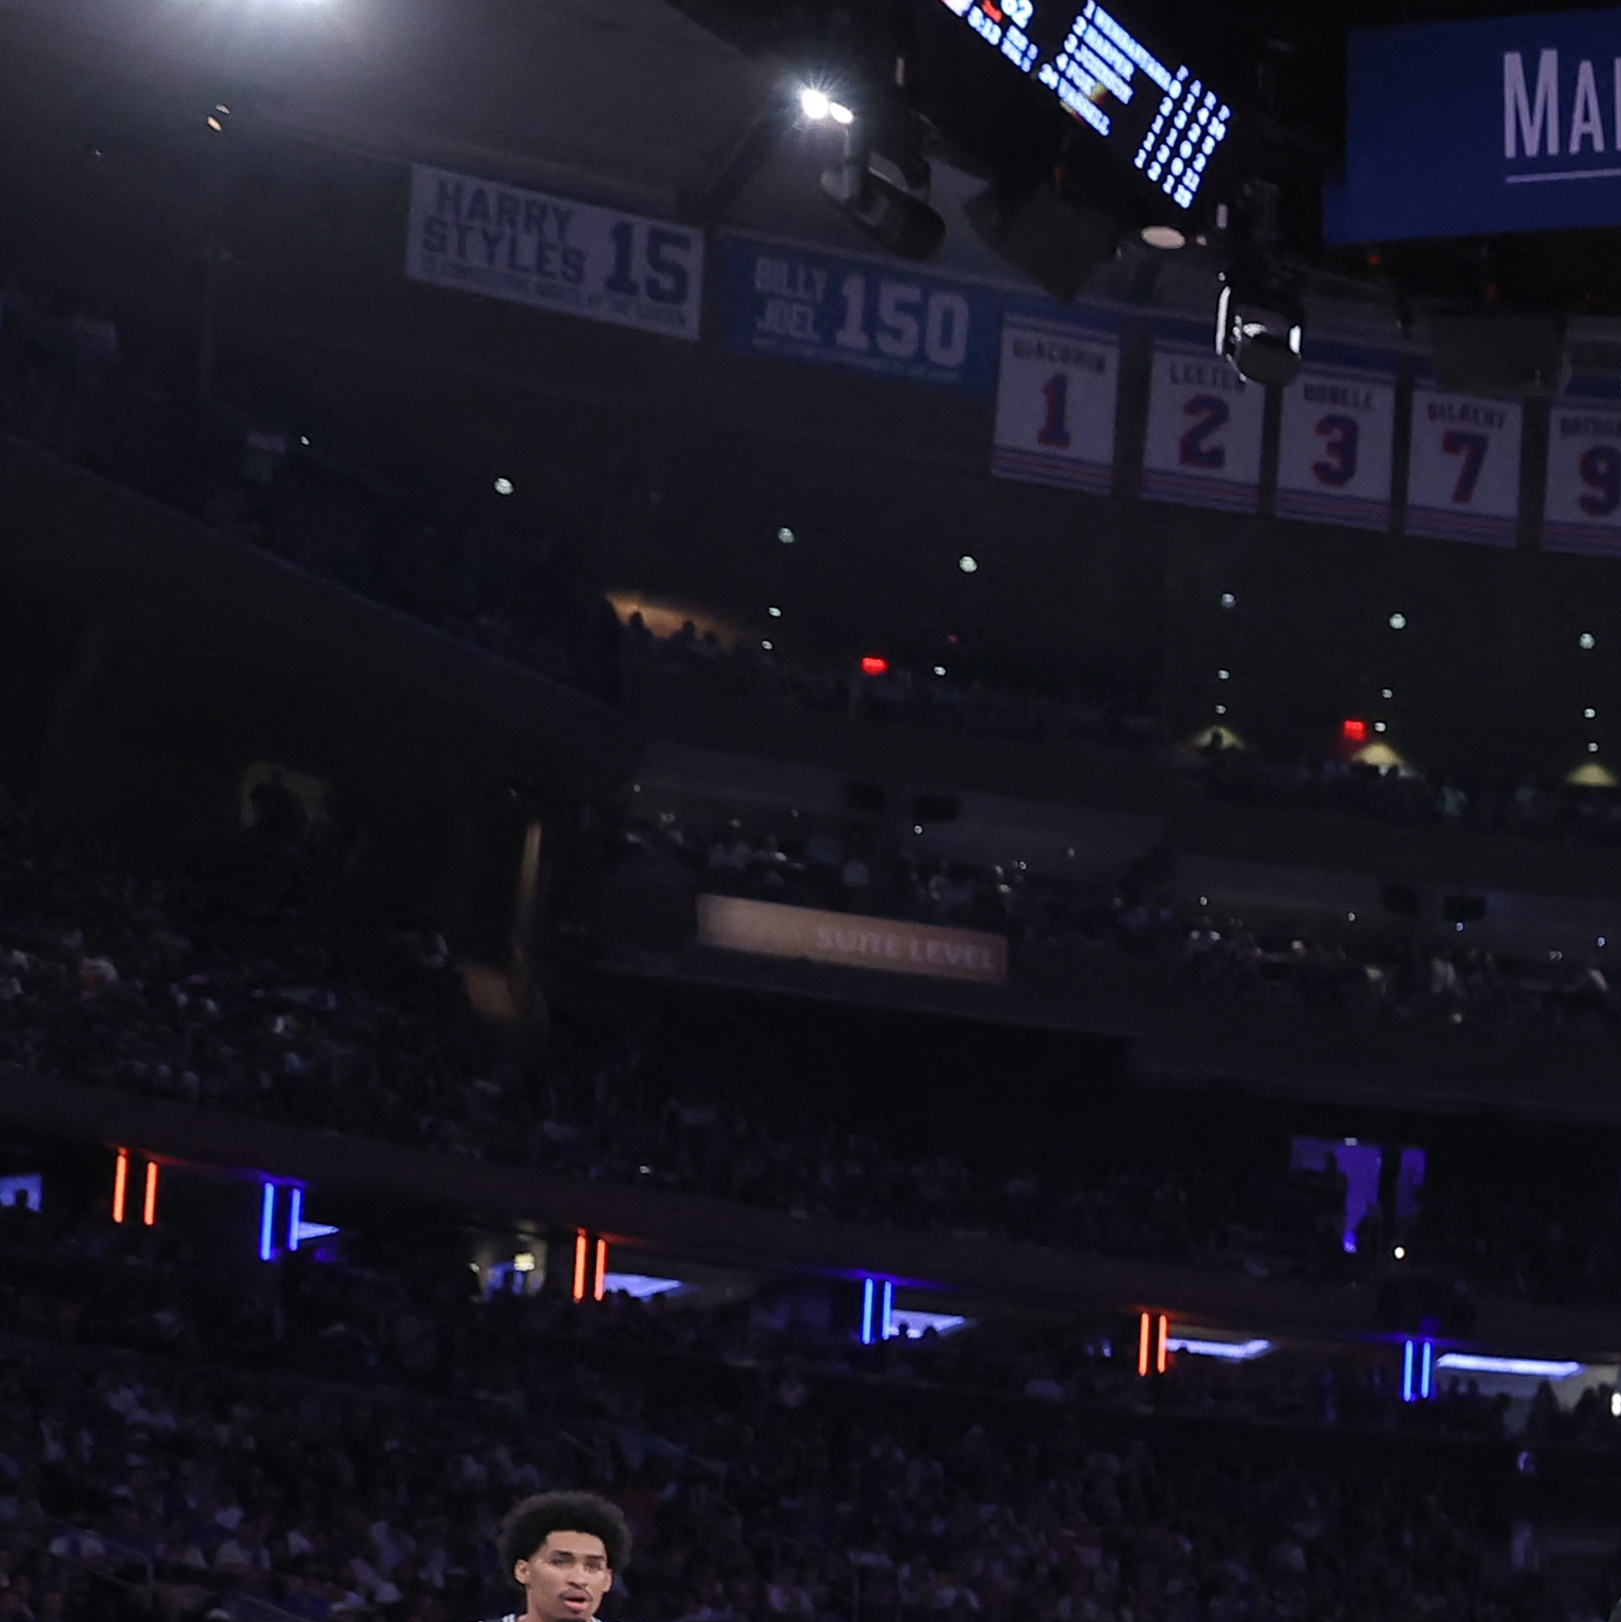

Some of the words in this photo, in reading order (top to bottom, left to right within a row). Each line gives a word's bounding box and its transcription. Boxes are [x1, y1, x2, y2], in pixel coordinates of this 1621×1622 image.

[437, 181, 574, 241] HARRY
[422, 215, 585, 283] STYLES
[604, 221, 691, 304] 15
[835, 274, 969, 367] 150
[1037, 373, 1071, 447] 1
[1179, 394, 1230, 468] 2
[1313, 413, 1358, 486] 3
[1442, 431, 1489, 502] 7
[1578, 445, 1621, 517] 9
